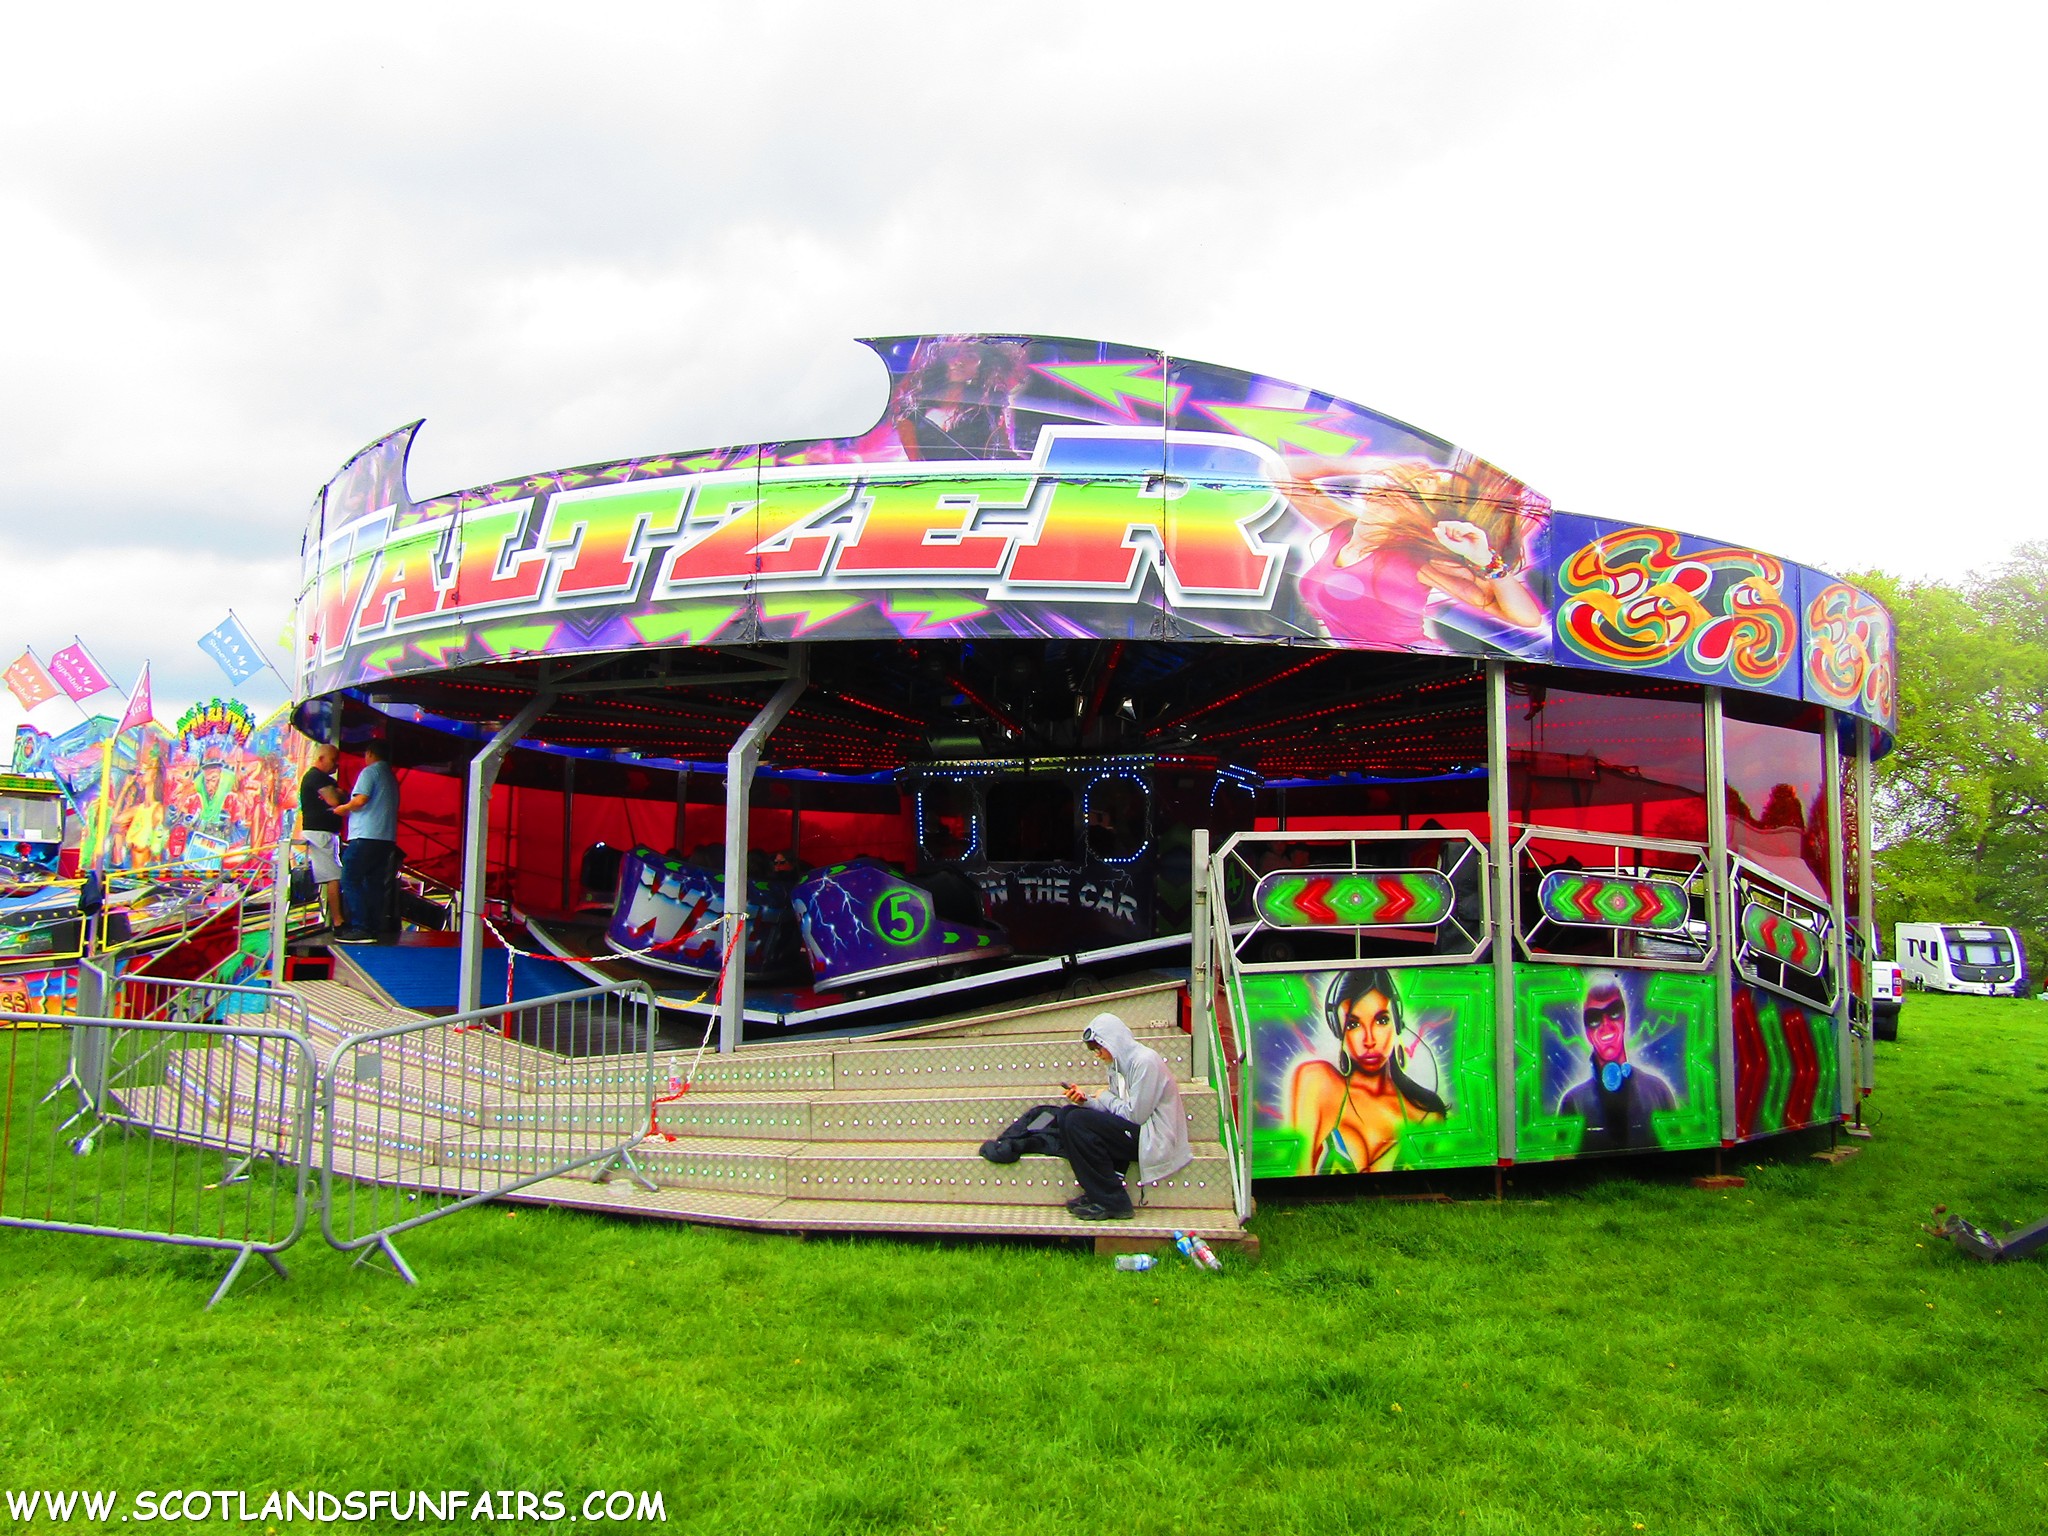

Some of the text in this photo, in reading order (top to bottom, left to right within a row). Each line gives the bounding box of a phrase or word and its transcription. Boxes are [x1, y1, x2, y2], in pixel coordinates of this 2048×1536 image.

[302, 424, 1292, 675] WALTZER
[59, 652, 94, 693] MIAMI
[212, 629, 249, 675] MIAMI
[890, 893, 915, 941] 5
[1018, 876, 1070, 904] THE
[1078, 881, 1138, 925] CAR
